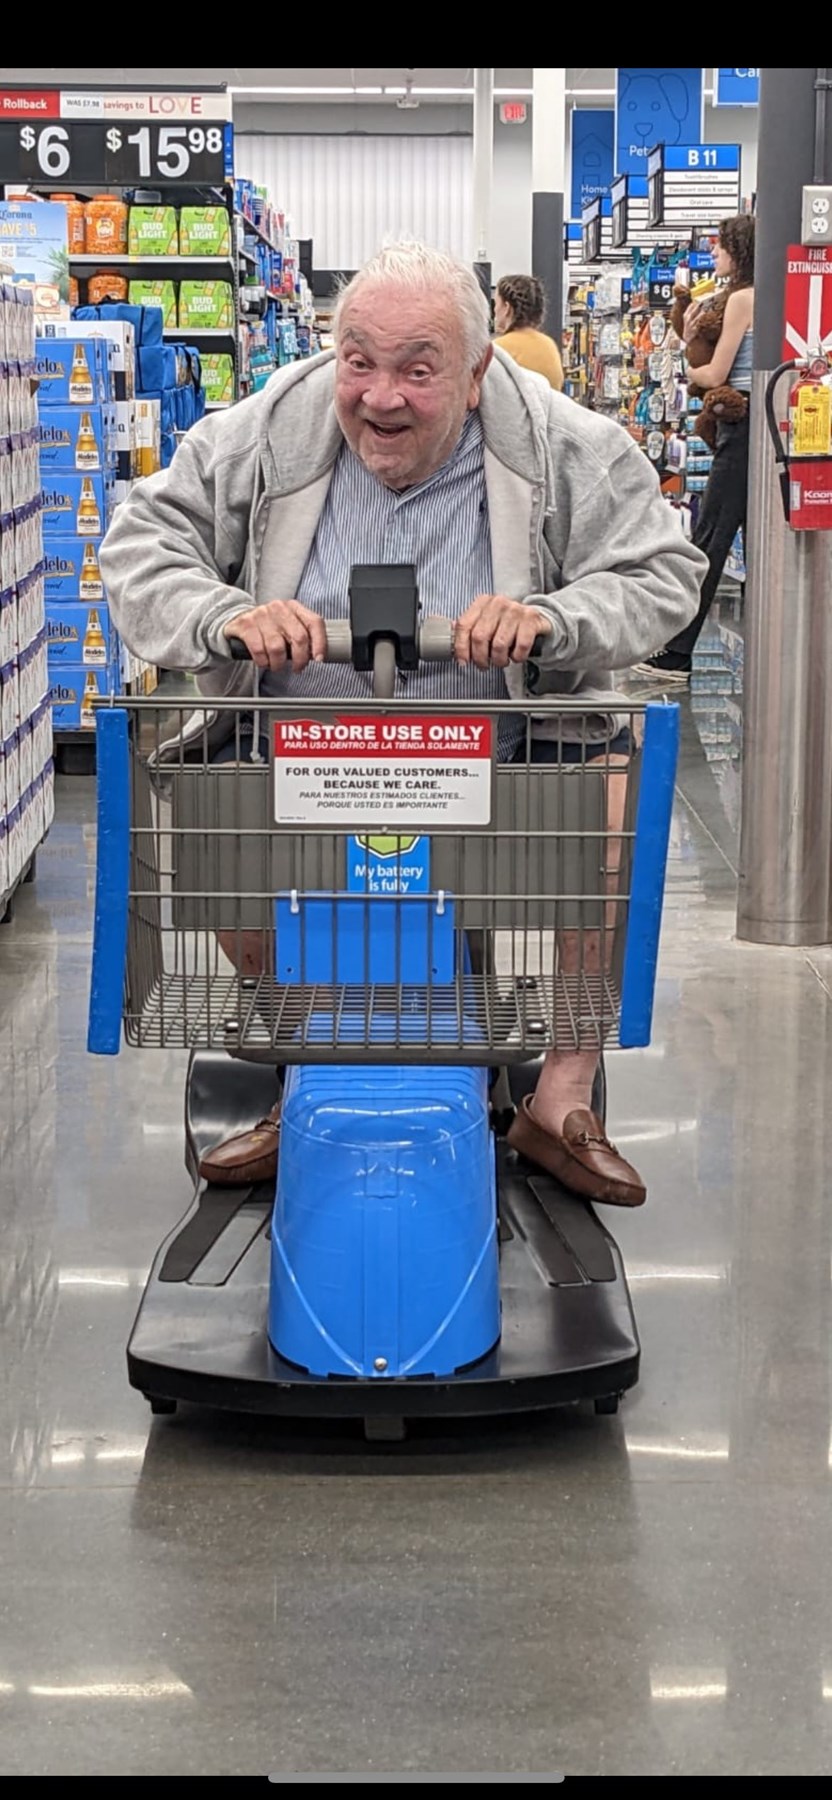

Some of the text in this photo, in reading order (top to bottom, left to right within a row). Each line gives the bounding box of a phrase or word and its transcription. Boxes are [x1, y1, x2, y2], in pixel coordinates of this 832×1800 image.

[3, 98, 48, 109] Rollback
[67, 99, 82, 107] WAS
[103, 96, 202, 114] savings to LOVE
[20, 125, 71, 177] $6
[688, 150, 717, 166] B 11
[581, 185, 608, 194] Home
[0, 223, 22, 237] AVE
[142, 222, 163, 231] BUD
[194, 222, 214, 231] BUD
[138, 230, 168, 239] LIGHT
[189, 231, 219, 240] LIGHT
[808, 248, 828, 261] FIRE
[141, 296, 162, 305] BUD
[192, 296, 213, 305] BUD
[188, 304, 217, 313] LIGHT
[202, 369, 217, 378] UD
[281, 725, 484, 741] IN-STORE USE ONLY
[284, 741, 480, 751] PARA USO DENTRO DE LA TIENDA SOLAMENTE
[285, 767, 479, 778] FOR OUR VALUED CUSTOMERS...
[323, 780, 441, 790] BECAUSE WE CARE.
[299, 791, 321, 799] PARA
[323, 791, 368, 799] NUESTROS
[370, 791, 418, 800] ESTIMADOS
[317, 801, 449, 809] PORQUE USTED ES IMPORTANTE
[355, 864, 375, 880] My
[369, 879, 379, 891] is
